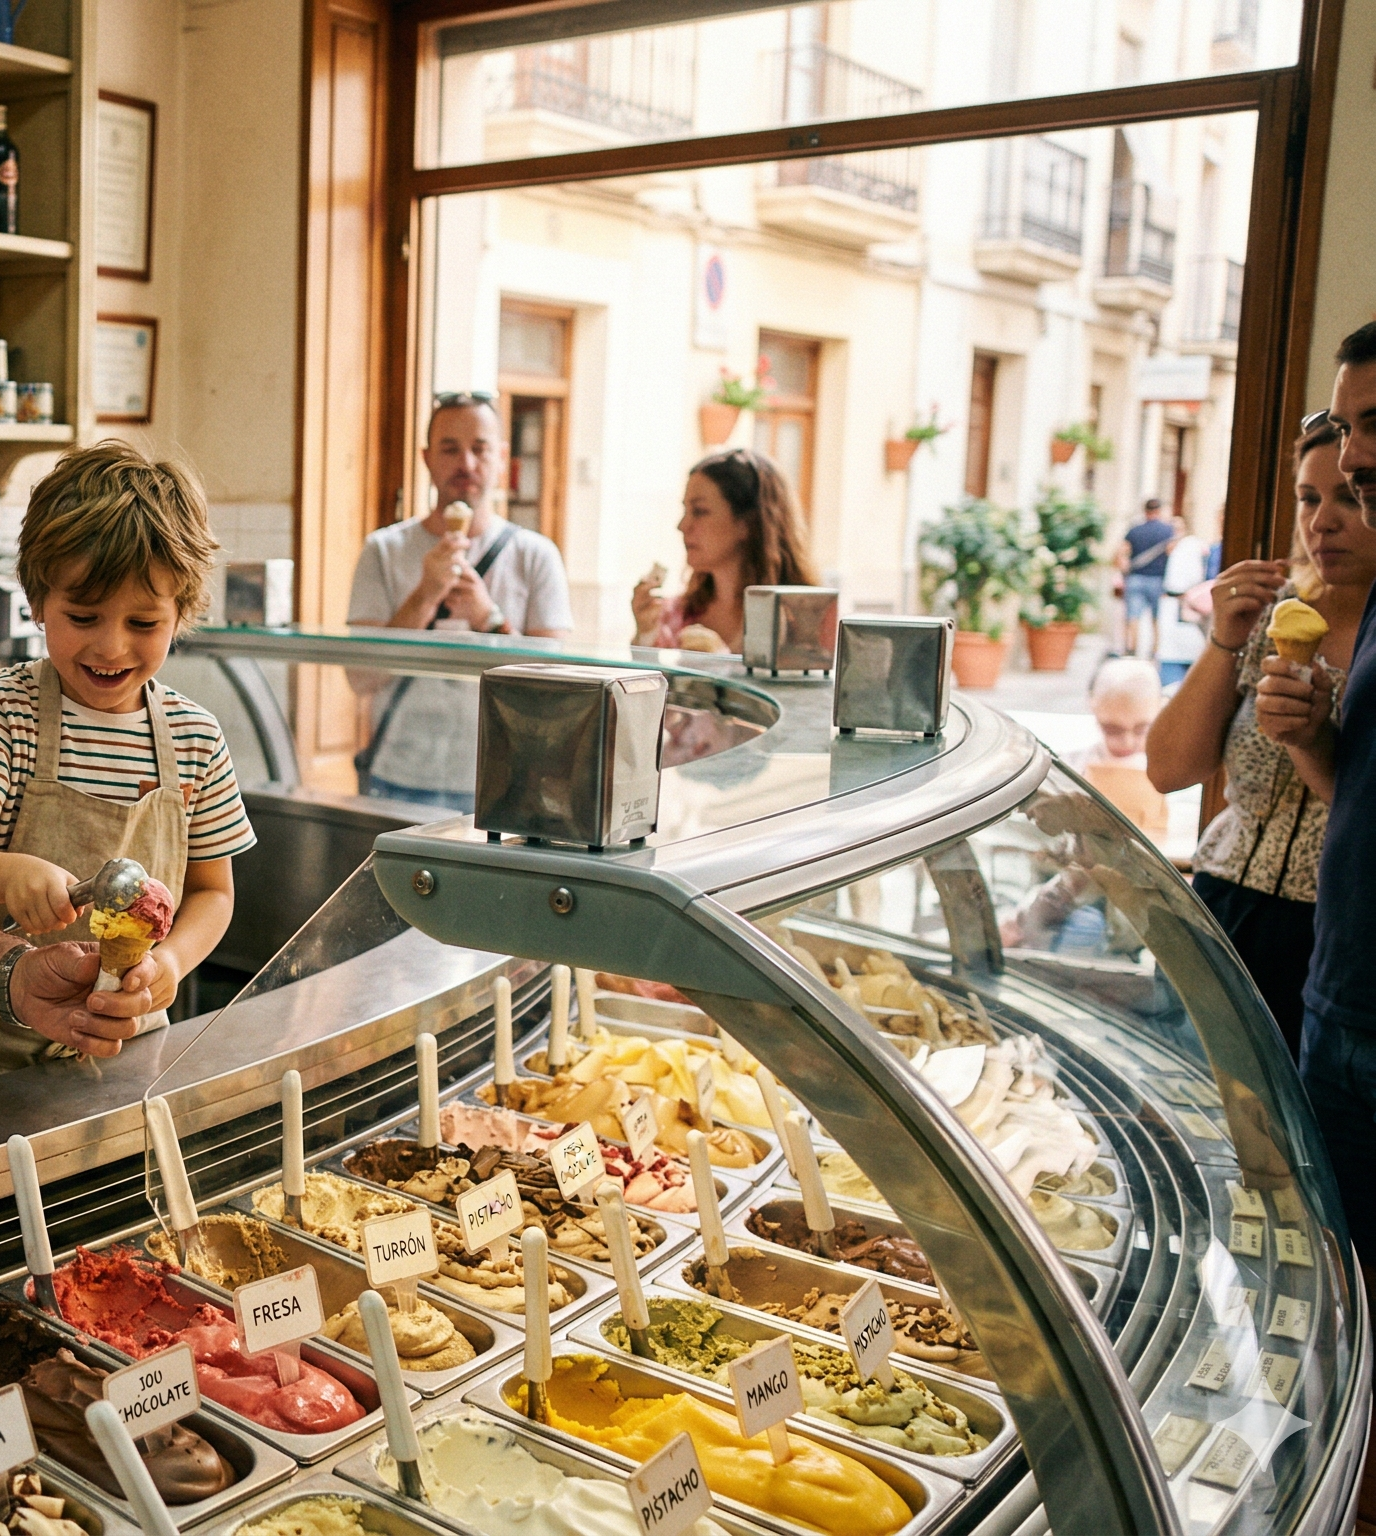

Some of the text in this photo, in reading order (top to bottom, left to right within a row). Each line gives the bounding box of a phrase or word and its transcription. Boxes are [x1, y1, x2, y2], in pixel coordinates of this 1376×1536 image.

[373, 1231, 426, 1263] TURRÓN
[252, 1296, 302, 1327] FRESA
[139, 1370, 163, 1391] JOU
[746, 1370, 788, 1409] MANGO
[118, 1381, 191, 1423] HOCOLATE
[641, 1468, 699, 1531] PISTACHO
